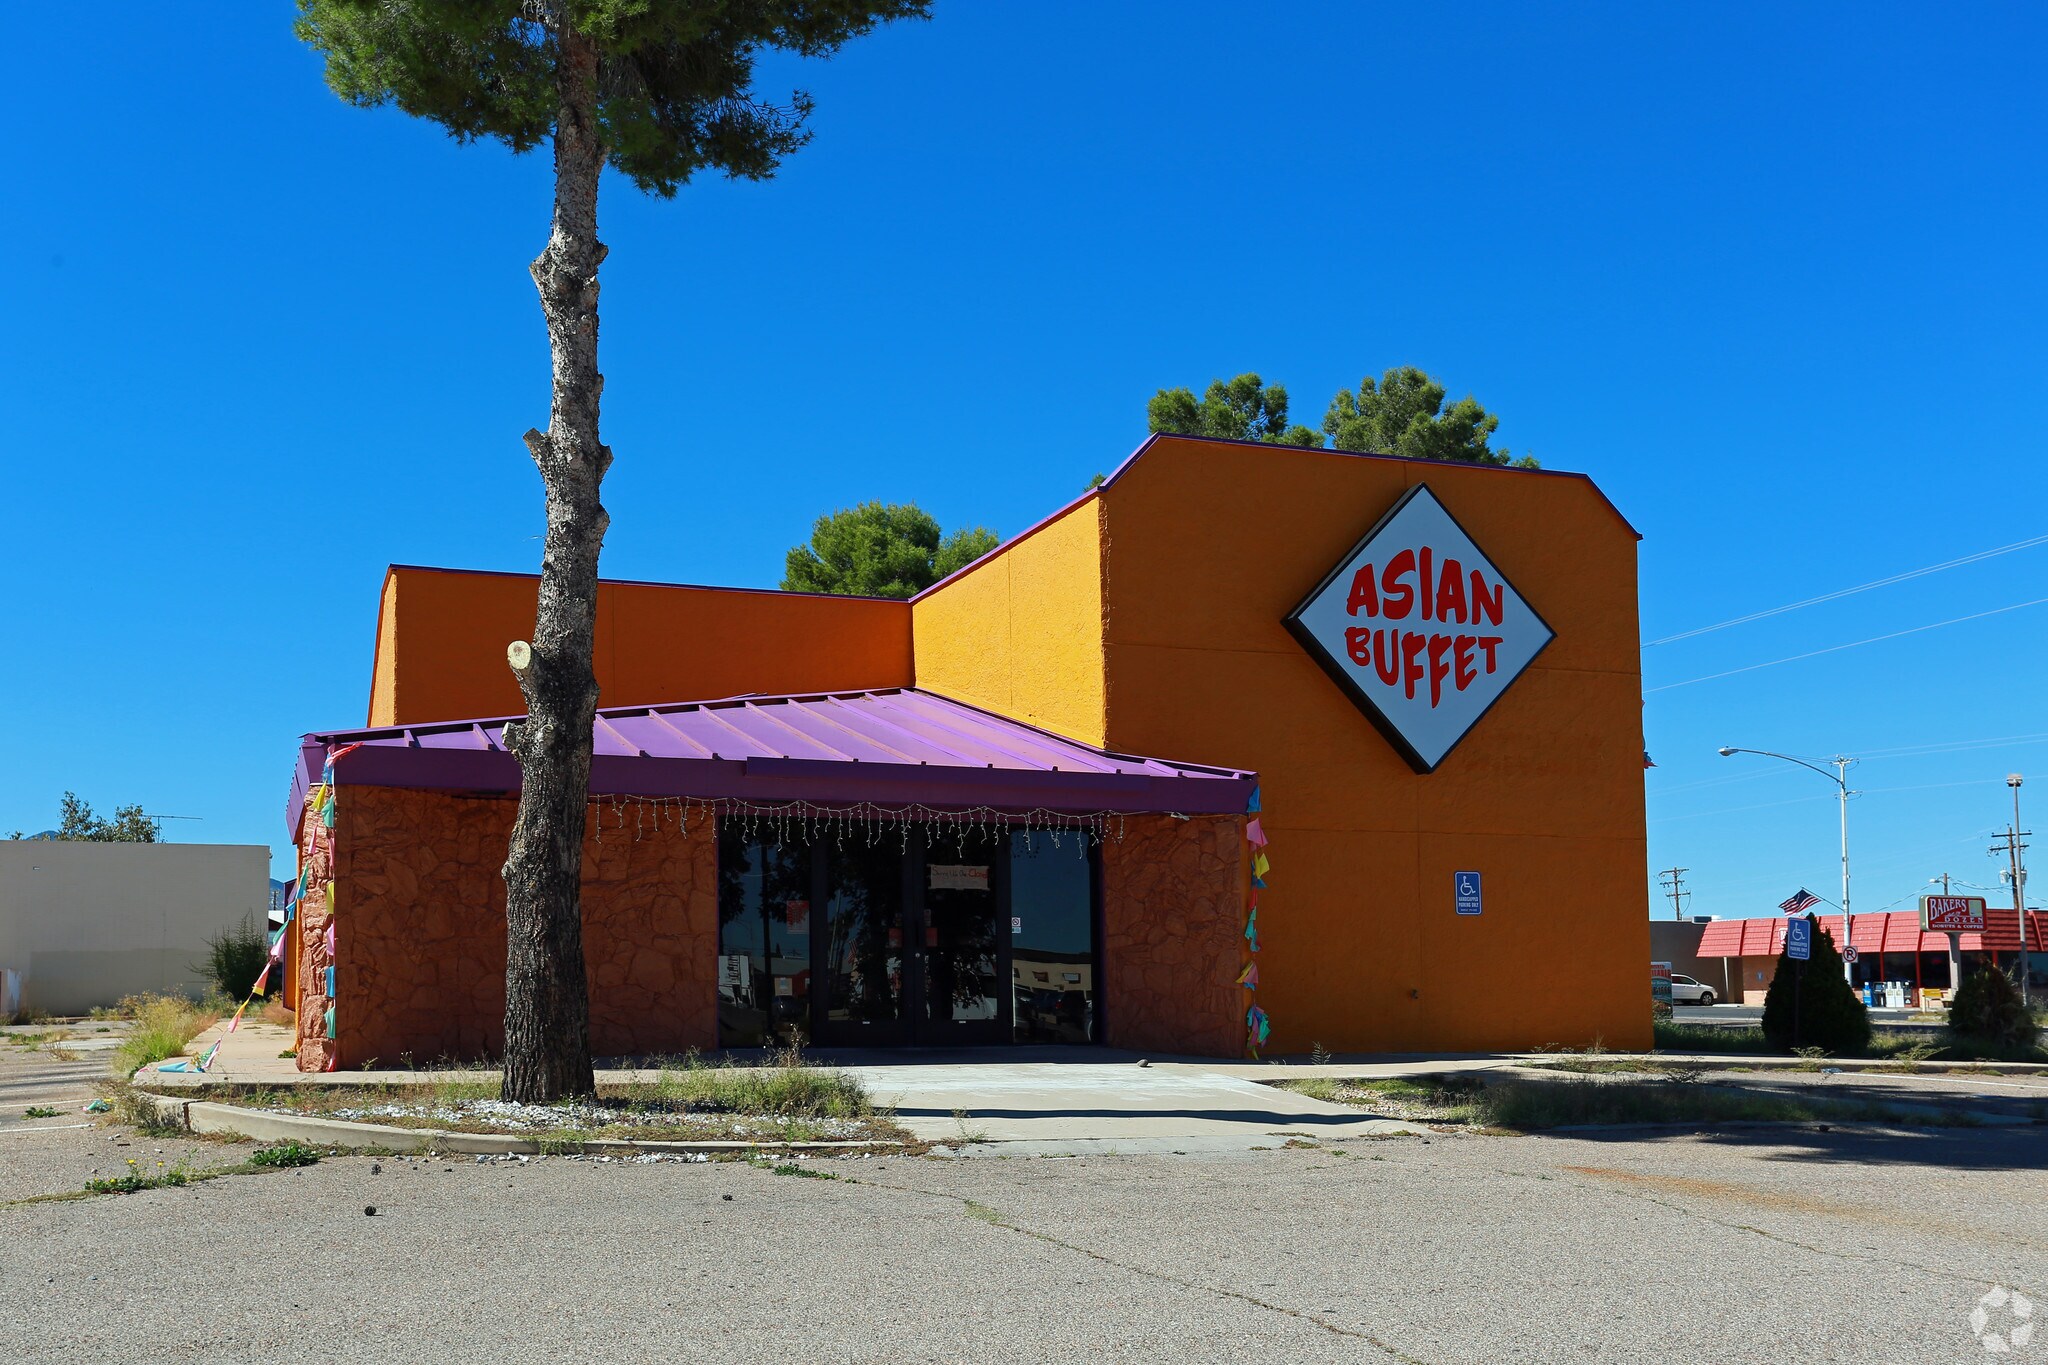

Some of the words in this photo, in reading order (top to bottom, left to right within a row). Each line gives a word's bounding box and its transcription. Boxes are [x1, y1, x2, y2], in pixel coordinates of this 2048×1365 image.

[1346, 546, 1503, 627] ASIAN
[1344, 626, 1503, 709] BUFFET
[1929, 898, 1967, 921] BAKERS
